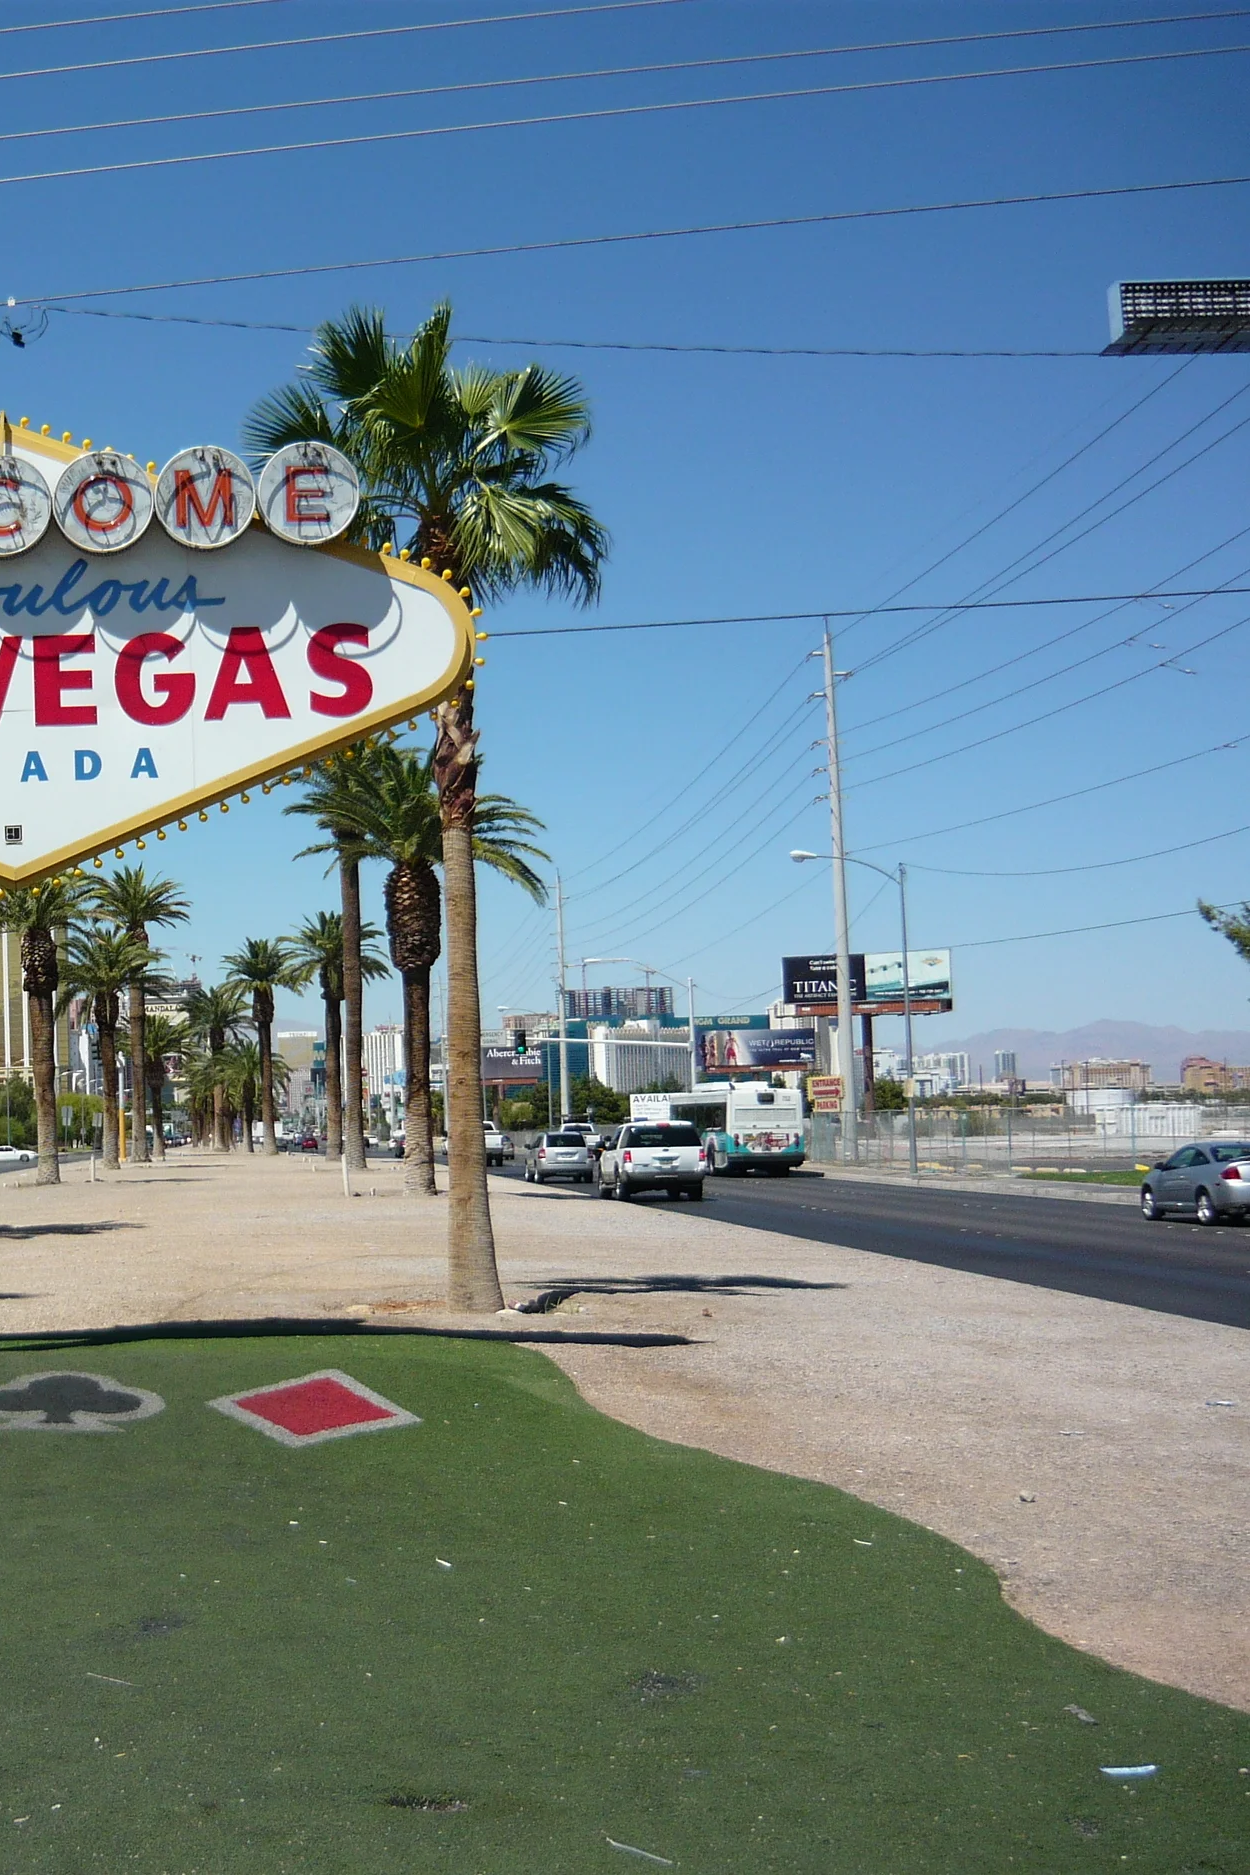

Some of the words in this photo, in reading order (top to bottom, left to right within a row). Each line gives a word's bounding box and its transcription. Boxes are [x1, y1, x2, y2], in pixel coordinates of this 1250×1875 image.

[793, 979, 857, 993] TITANC
[717, 1015, 751, 1025] GRAND
[774, 1038, 815, 1046] REPUBLIC
[486, 1047, 541, 1058] Abercrbie
[511, 1058, 518, 1066] &
[519, 1055, 541, 1065] Fitch
[632, 1094, 670, 1103] AVAILA
